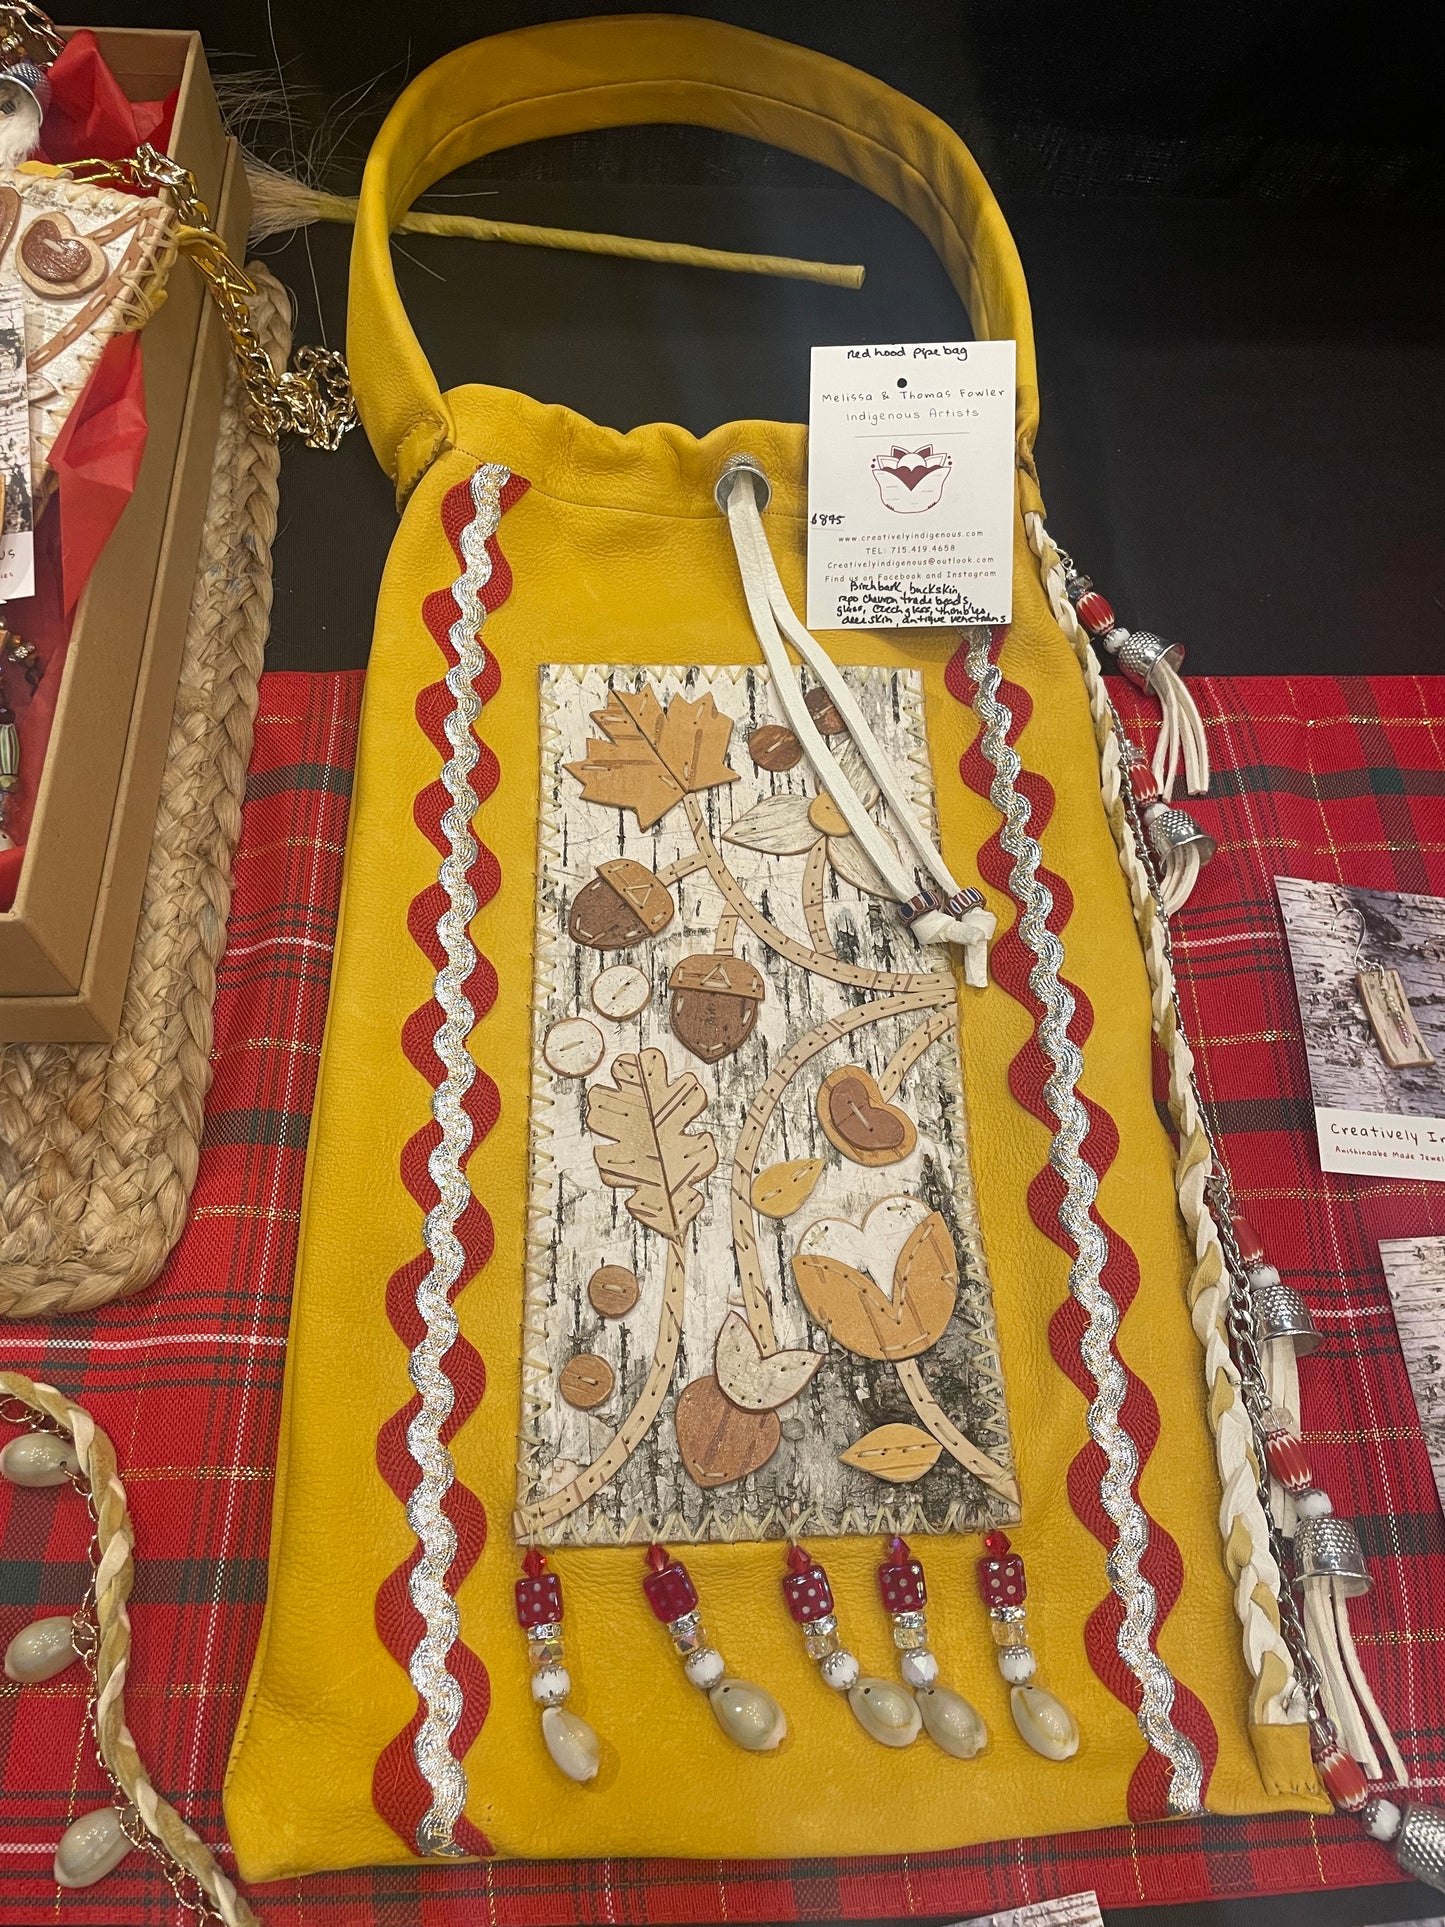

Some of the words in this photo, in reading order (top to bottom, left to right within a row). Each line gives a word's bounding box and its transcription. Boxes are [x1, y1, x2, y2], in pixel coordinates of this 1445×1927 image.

[847, 349, 870, 359] red
[875, 347, 906, 357] hood
[913, 347, 940, 360] pipe
[944, 345, 968, 361] bag
[822, 393, 873, 403] Melissa
[881, 391, 890, 400] &
[900, 390, 951, 400] Thomas
[960, 389, 1006, 398] Fowler
[846, 411, 920, 425] Indigenous
[930, 408, 979, 419] Artists
[838, 530, 984, 543] www.creativelyindigenous.com
[866, 547, 886, 555] TEL:
[891, 544, 956, 554] 715.419.4658
[827, 556, 995, 570] Creativelyindigenous@outlook.com
[877, 572, 922, 581] Facebook
[947, 571, 997, 579] Instagram
[1330, 1123, 1418, 1146] Creatively
[1335, 1145, 1388, 1158] Anishinaabe
[1392, 1151, 1415, 1160] Made
